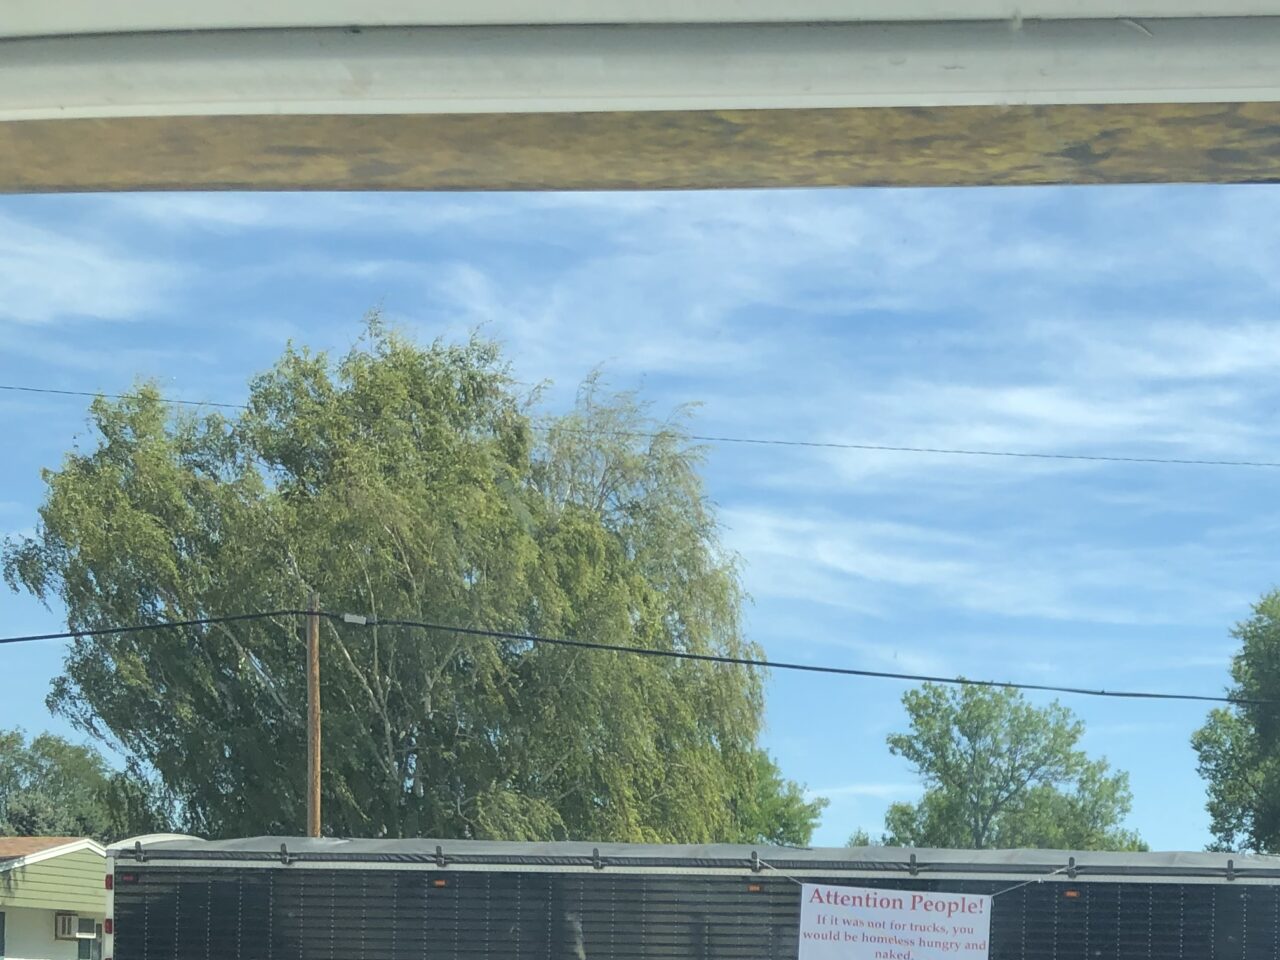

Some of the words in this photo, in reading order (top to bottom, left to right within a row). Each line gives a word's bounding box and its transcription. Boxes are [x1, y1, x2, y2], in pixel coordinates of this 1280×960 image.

[809, 887, 904, 910] Attention
[910, 894, 984, 918] People!
[816, 914, 827, 925] If
[830, 915, 839, 926] it
[842, 918, 865, 928] was
[867, 920, 886, 930] not
[889, 921, 907, 931] for
[909, 922, 949, 935] trucks,
[952, 925, 975, 936] you
[803, 930, 841, 941] would
[844, 932, 859, 943] be
[861, 932, 915, 947] homeless
[918, 936, 961, 953] hungry
[964, 941, 986, 951] and
[875, 949, 915, 960] naked.
